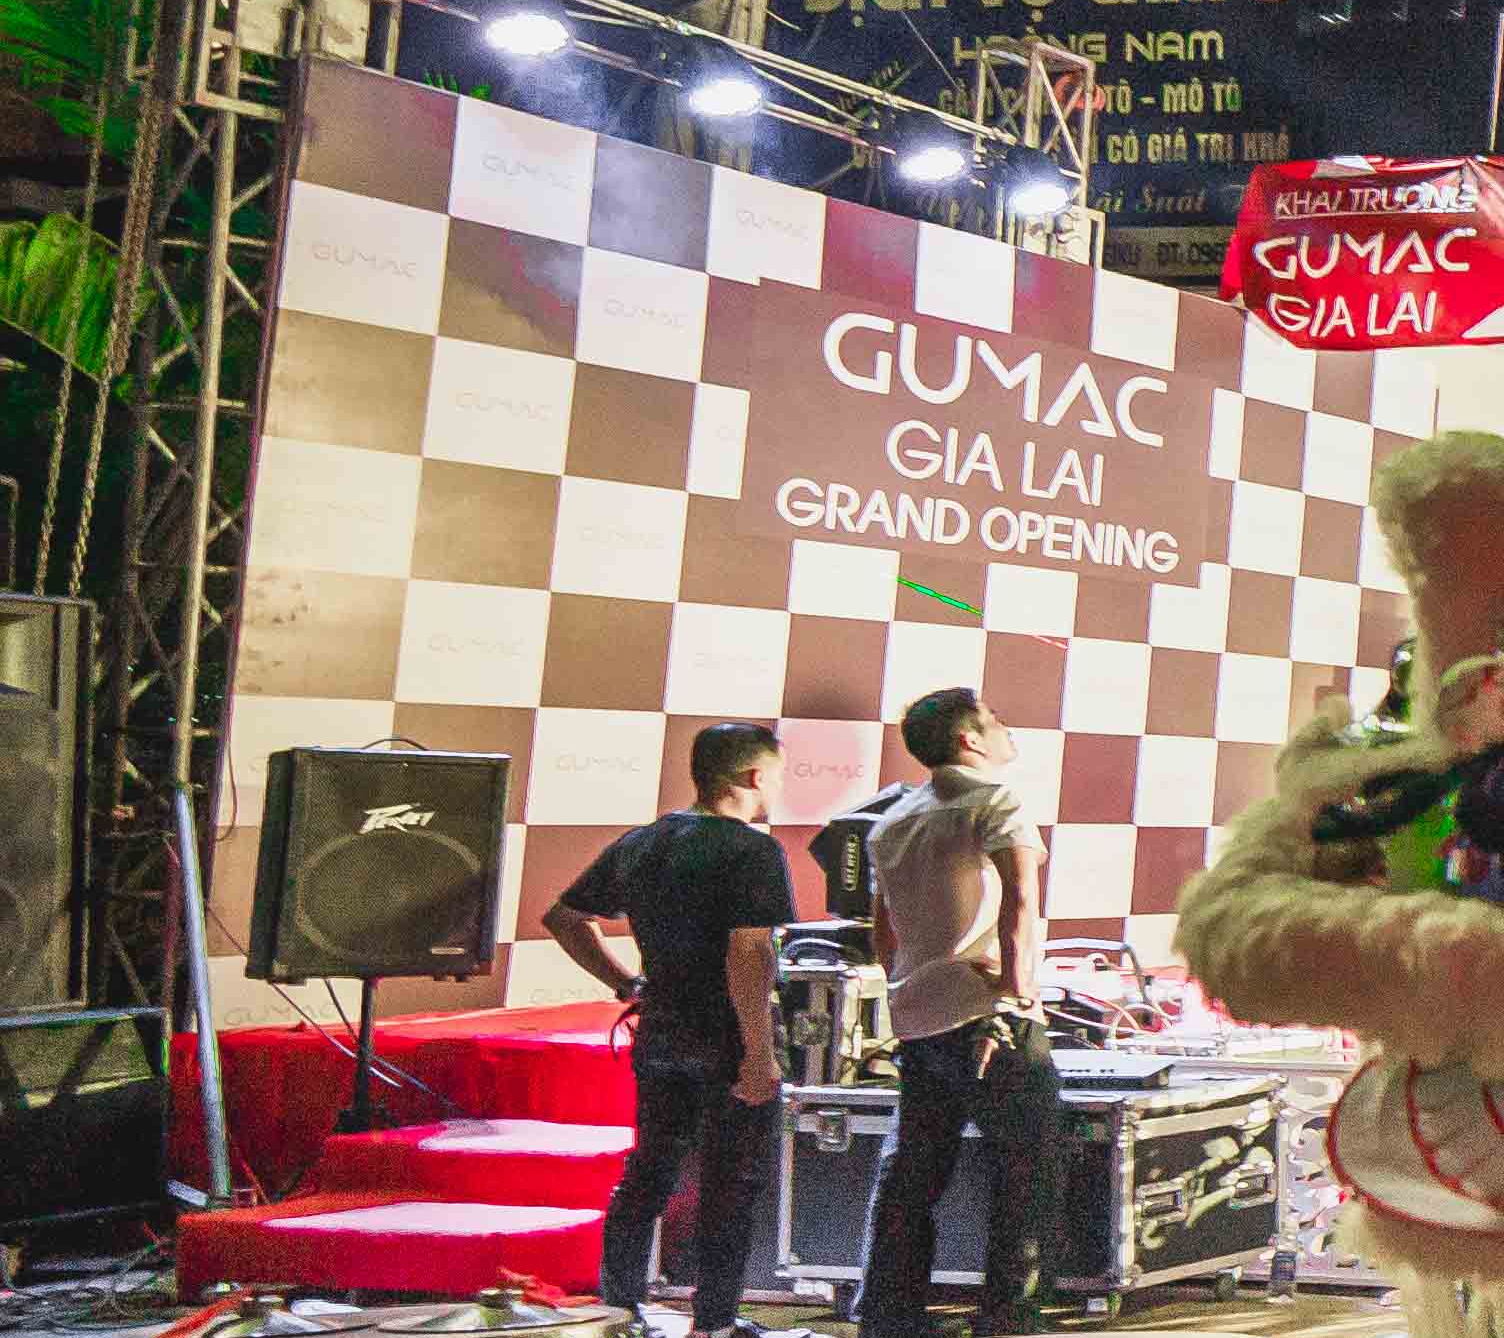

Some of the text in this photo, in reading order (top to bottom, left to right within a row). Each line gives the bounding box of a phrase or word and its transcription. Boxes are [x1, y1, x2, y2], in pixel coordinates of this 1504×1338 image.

[1124, 29, 1225, 62] NAM
[1275, 190, 1342, 216] KHAI
[1251, 227, 1478, 281] GUMAC
[1266, 289, 1438, 338] GIA LAI
[822, 312, 1168, 448] GUMAC
[885, 419, 1105, 507] GIA LAI
[774, 477, 1181, 575] GRAND OPENING
